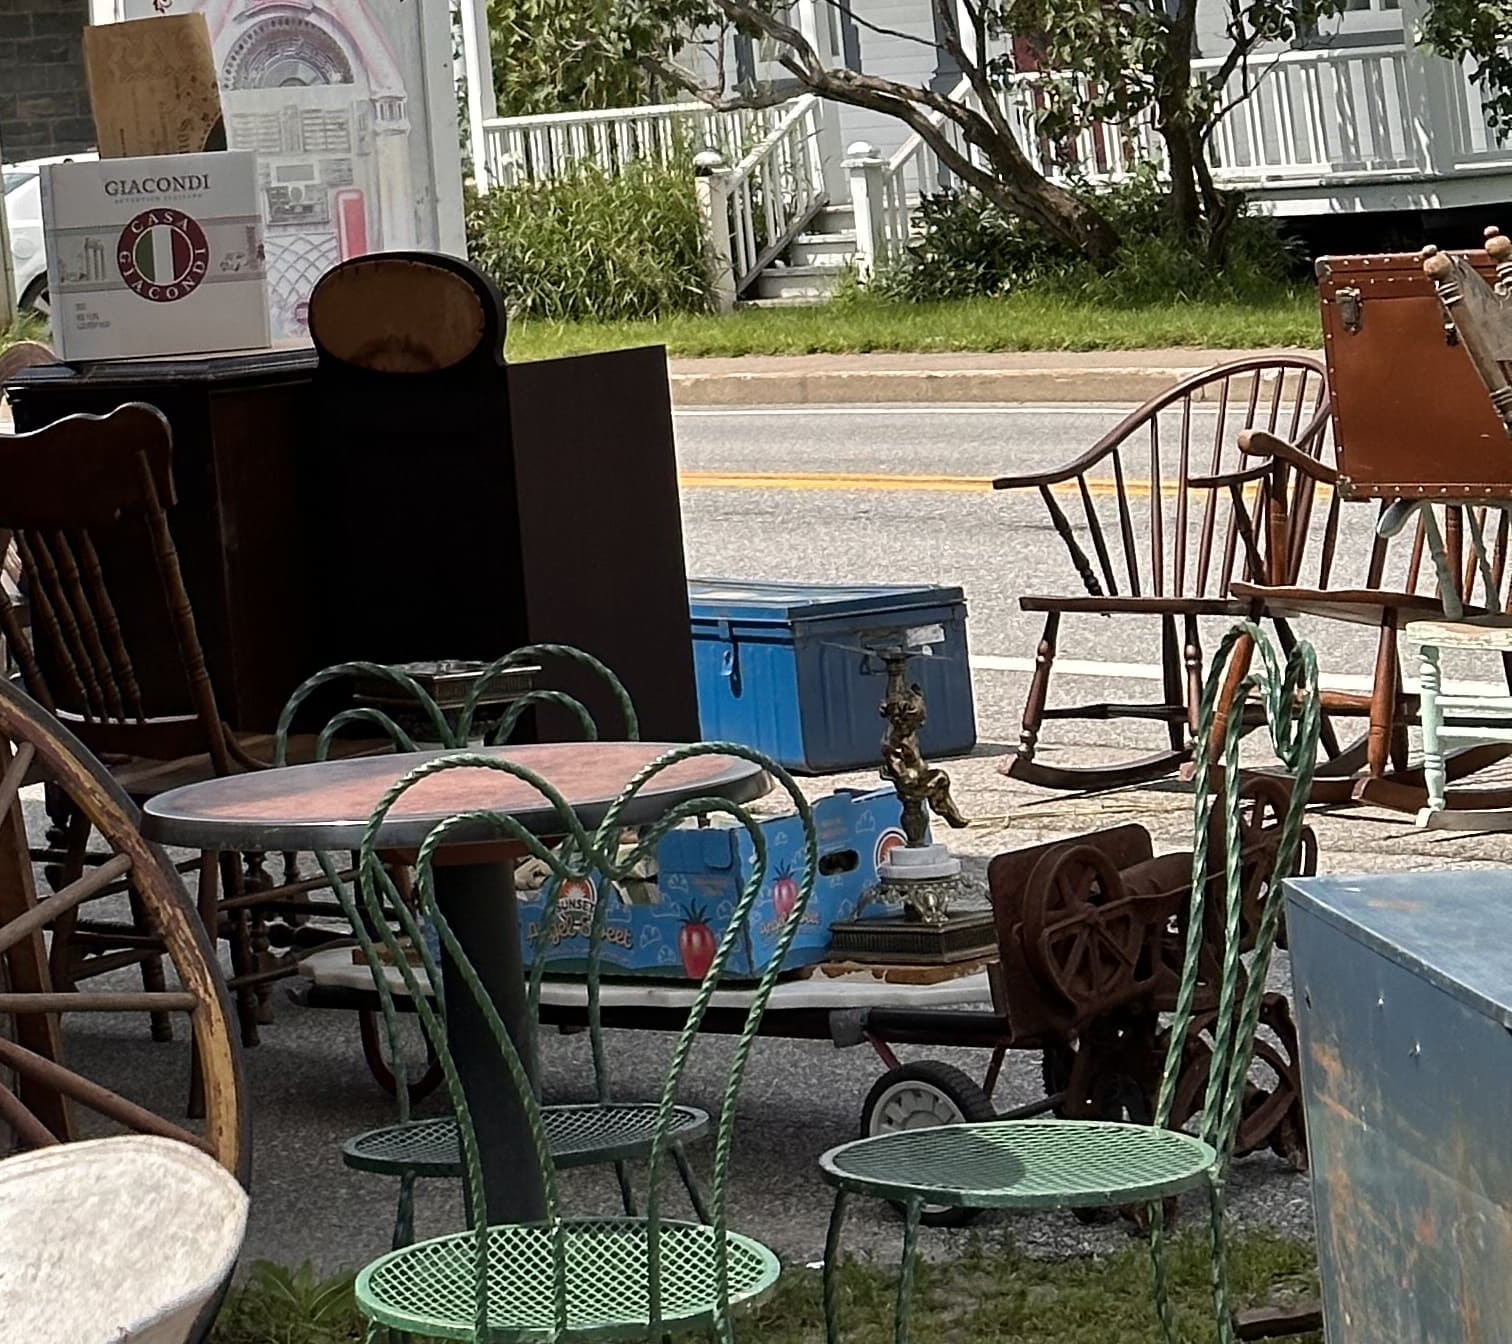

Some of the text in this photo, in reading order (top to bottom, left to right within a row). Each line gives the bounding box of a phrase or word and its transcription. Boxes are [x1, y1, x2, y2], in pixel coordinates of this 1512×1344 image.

[104, 174, 210, 196] GIACONDI
[130, 211, 189, 234] CASA
[119, 247, 206, 300] GIACONDI
[557, 897, 595, 912] UNSET
